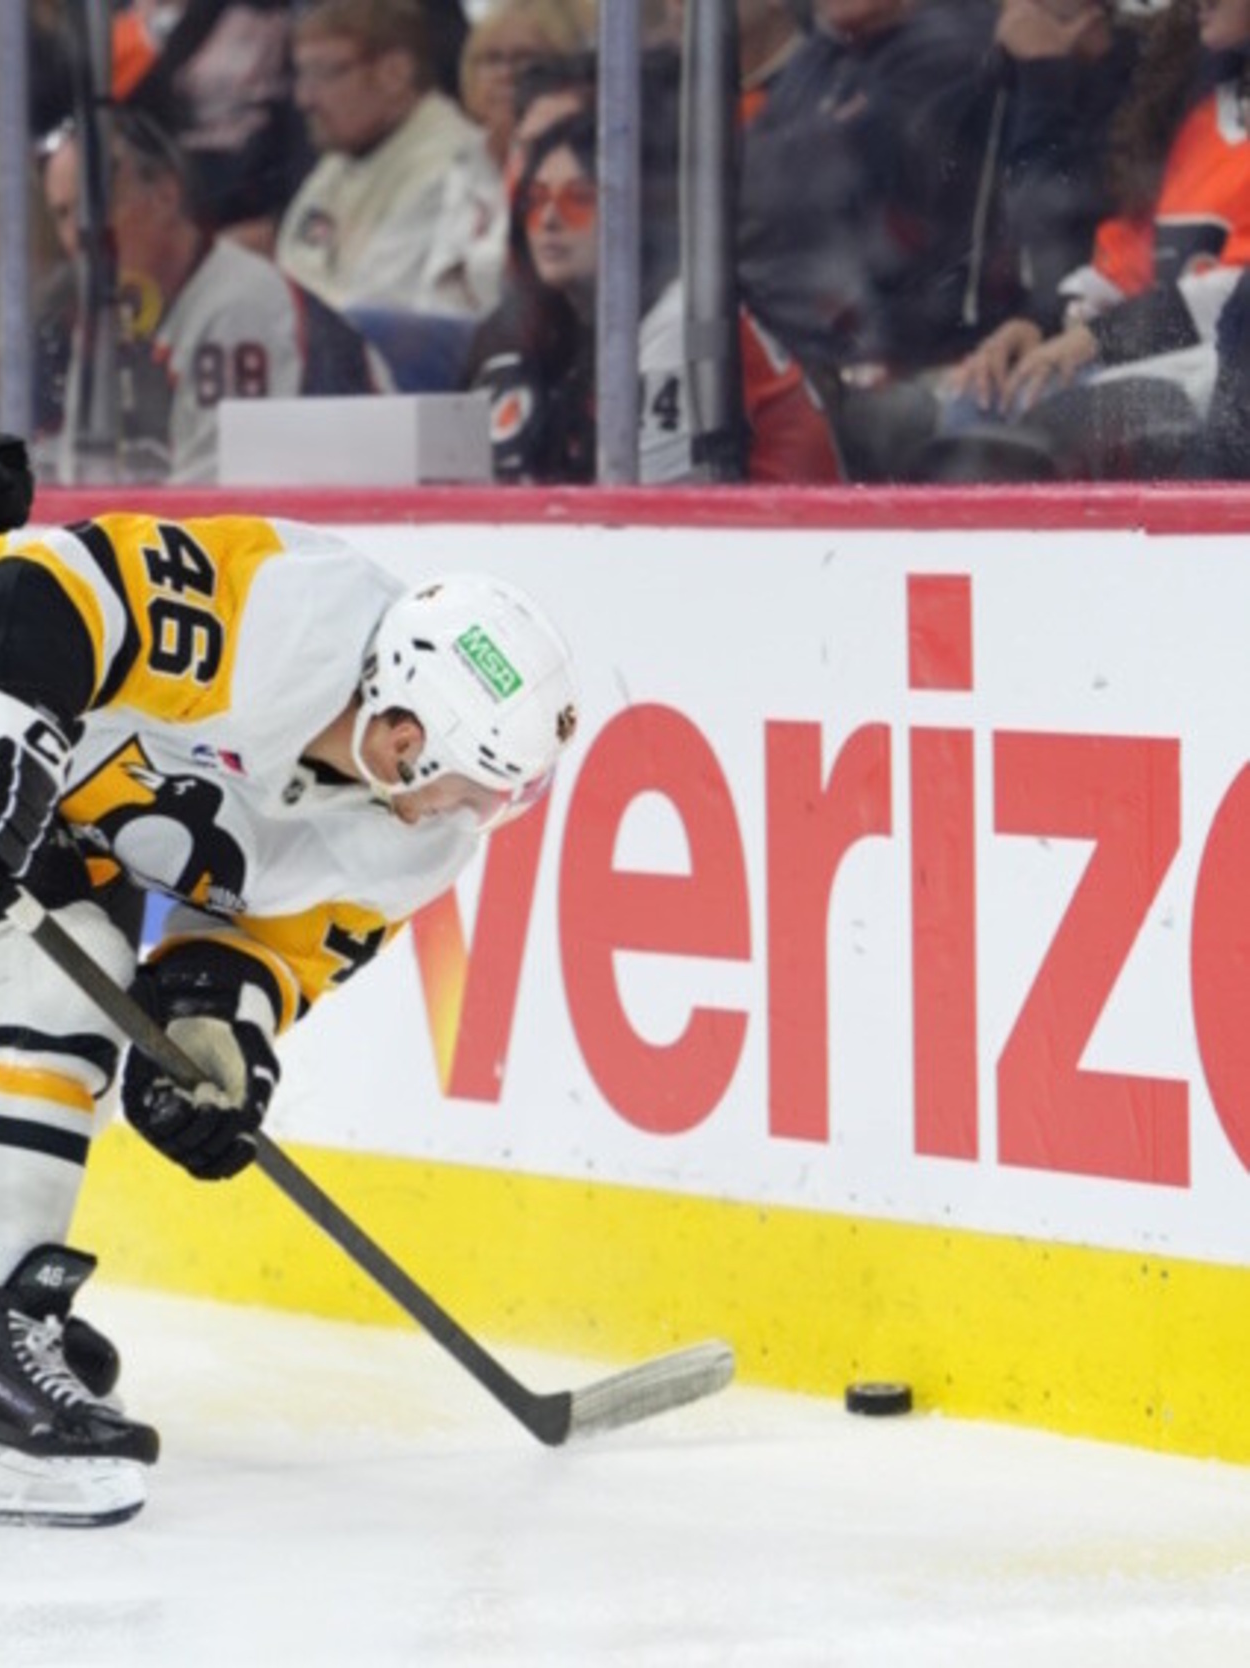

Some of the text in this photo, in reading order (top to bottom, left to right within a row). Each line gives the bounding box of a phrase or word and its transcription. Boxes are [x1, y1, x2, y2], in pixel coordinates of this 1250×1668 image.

[142, 523, 225, 684] 46
[458, 625, 522, 697] MSA
[35, 1263, 65, 1288] 46
